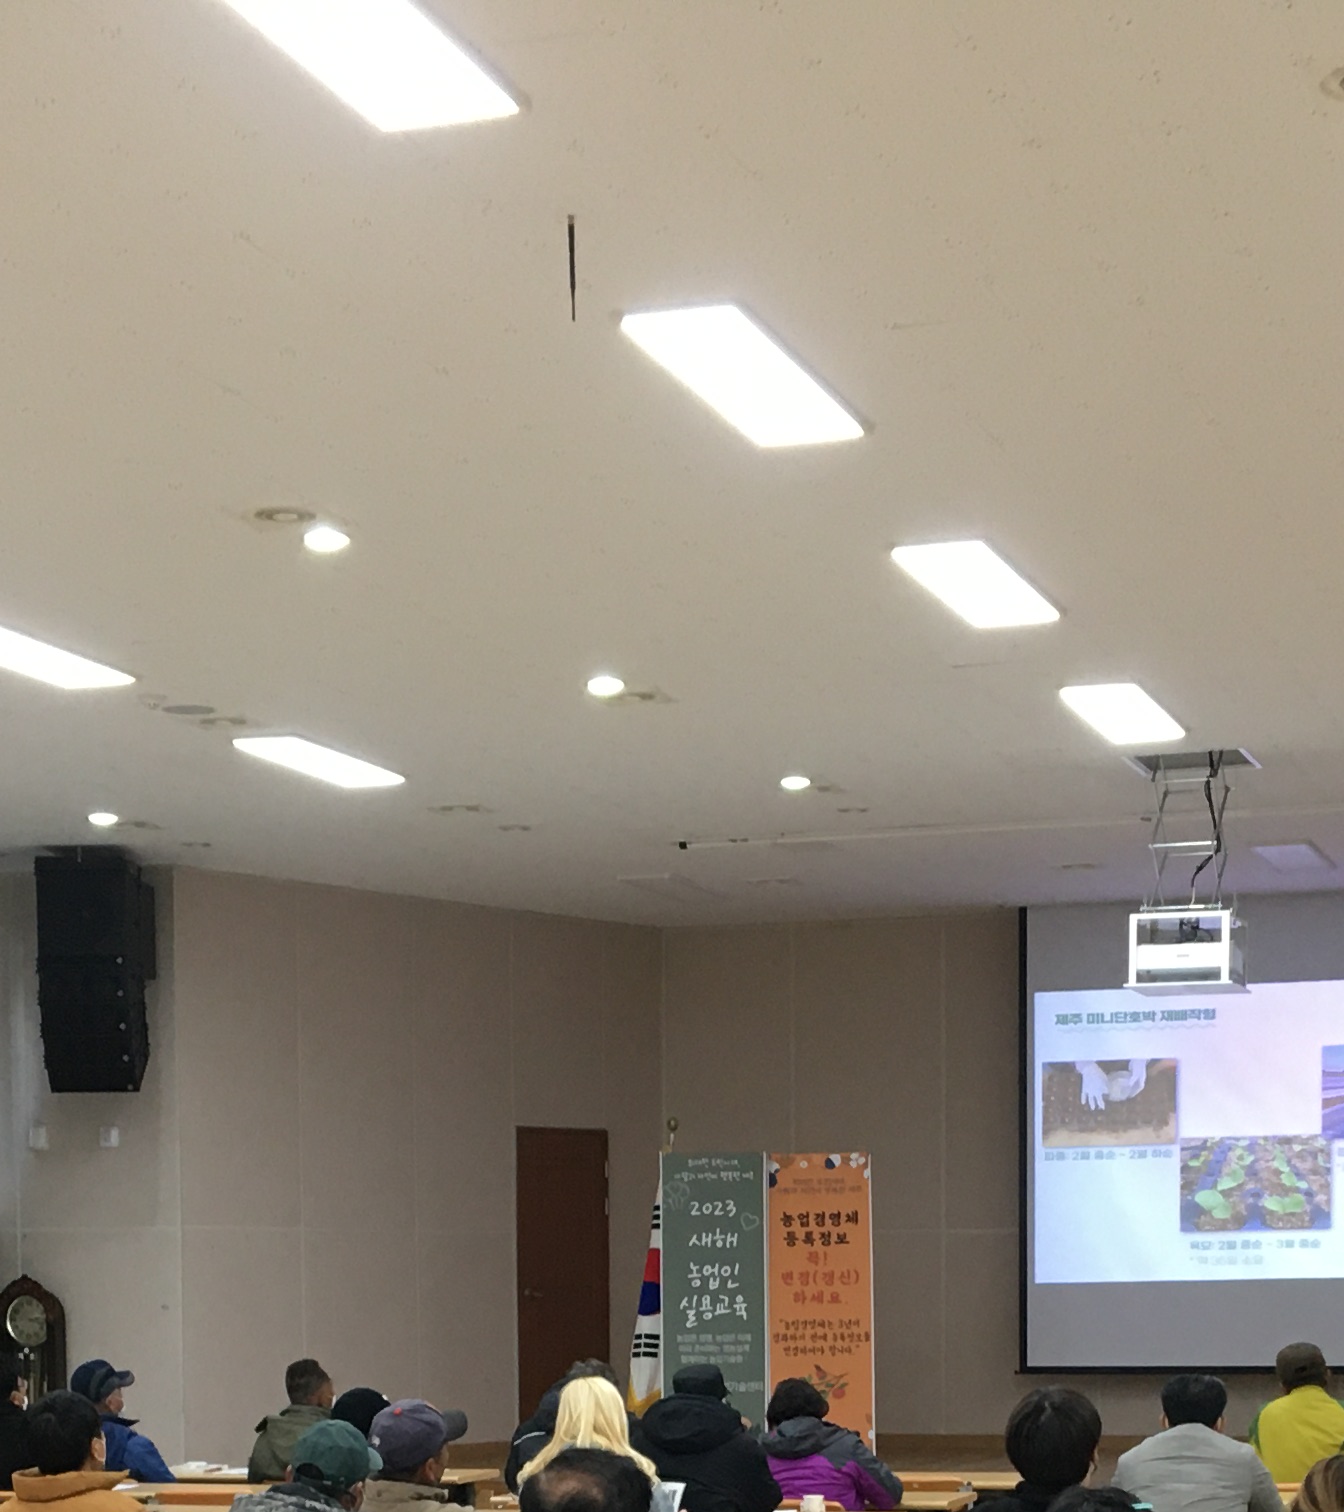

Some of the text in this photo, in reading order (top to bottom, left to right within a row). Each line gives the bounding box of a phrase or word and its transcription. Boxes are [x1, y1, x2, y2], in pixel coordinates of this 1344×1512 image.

[1055, 1012, 1083, 1025] 제주
[690, 1200, 736, 1217] 2023
[780, 1210, 858, 1228] 농업경영체
[689, 1228, 738, 1248] 새해
[784, 1231, 850, 1247] 등록정보
[688, 1262, 739, 1290] 농업인
[680, 1295, 747, 1328] 실용교육
